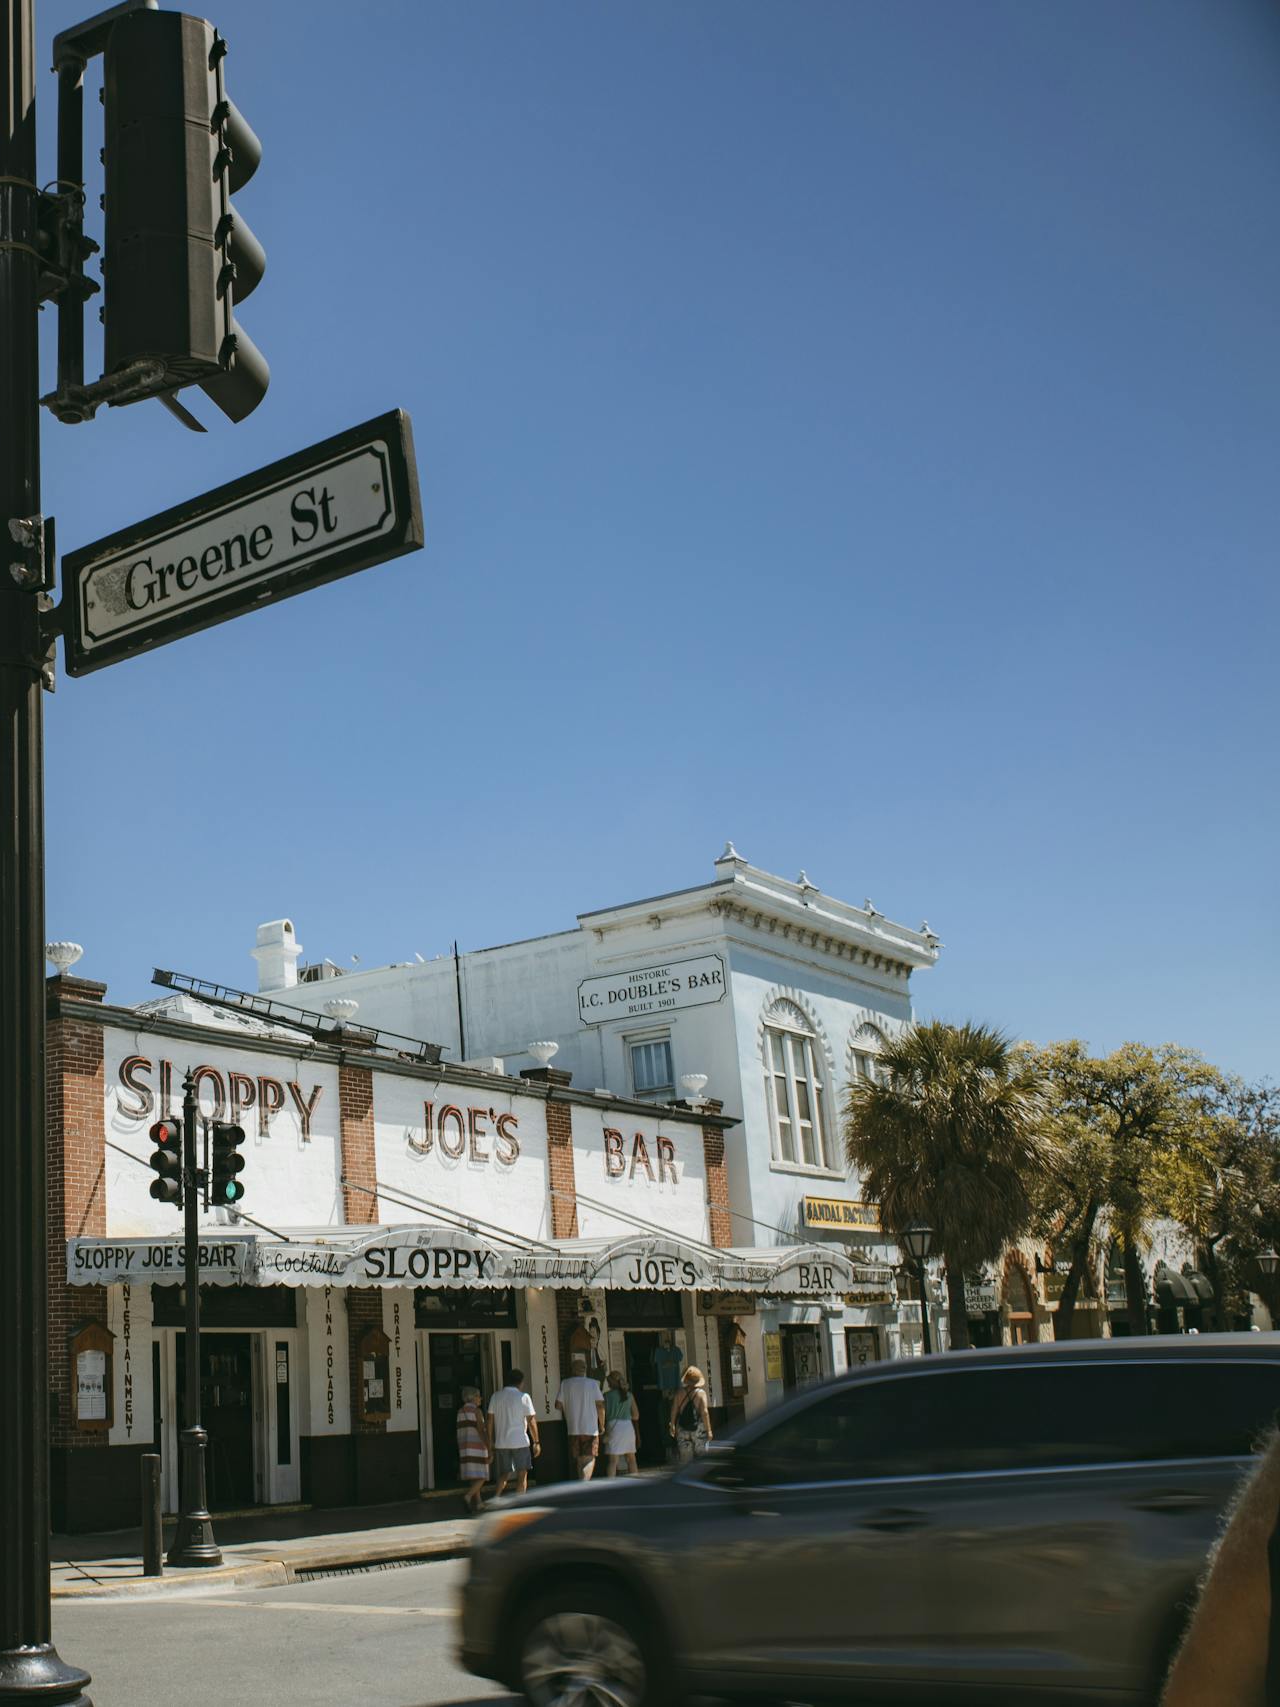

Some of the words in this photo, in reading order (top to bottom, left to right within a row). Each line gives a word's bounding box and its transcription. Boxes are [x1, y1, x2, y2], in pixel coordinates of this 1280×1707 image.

[124, 523, 274, 611] Greene
[290, 486, 338, 547] St
[608, 978, 682, 1005] DOUBLE'S
[688, 969, 722, 990] BAR
[628, 968, 671, 983] HISTORIC
[628, 1001, 654, 1014] BUILT
[658, 998, 676, 1008] 1901
[118, 1054, 323, 1143] SLOPPY
[407, 1100, 521, 1166] JOE'S
[602, 1126, 680, 1185] BAR
[75, 1246, 135, 1270] SLOPPY
[142, 1244, 186, 1268] JOE'S
[198, 1244, 237, 1267] BAR
[275, 1251, 344, 1275] Cocktails
[364, 1247, 491, 1279] SLOPPY
[628, 1257, 696, 1286] JOE'S
[798, 1265, 834, 1289] BAR
[966, 1303, 993, 1311] HOUSE
[393, 1303, 402, 1358] DRAFT
[122, 1282, 133, 1439] NTERTAINMENT
[541, 1325, 550, 1415] COCKTAILS
[326, 1345, 334, 1425] COLADAS
